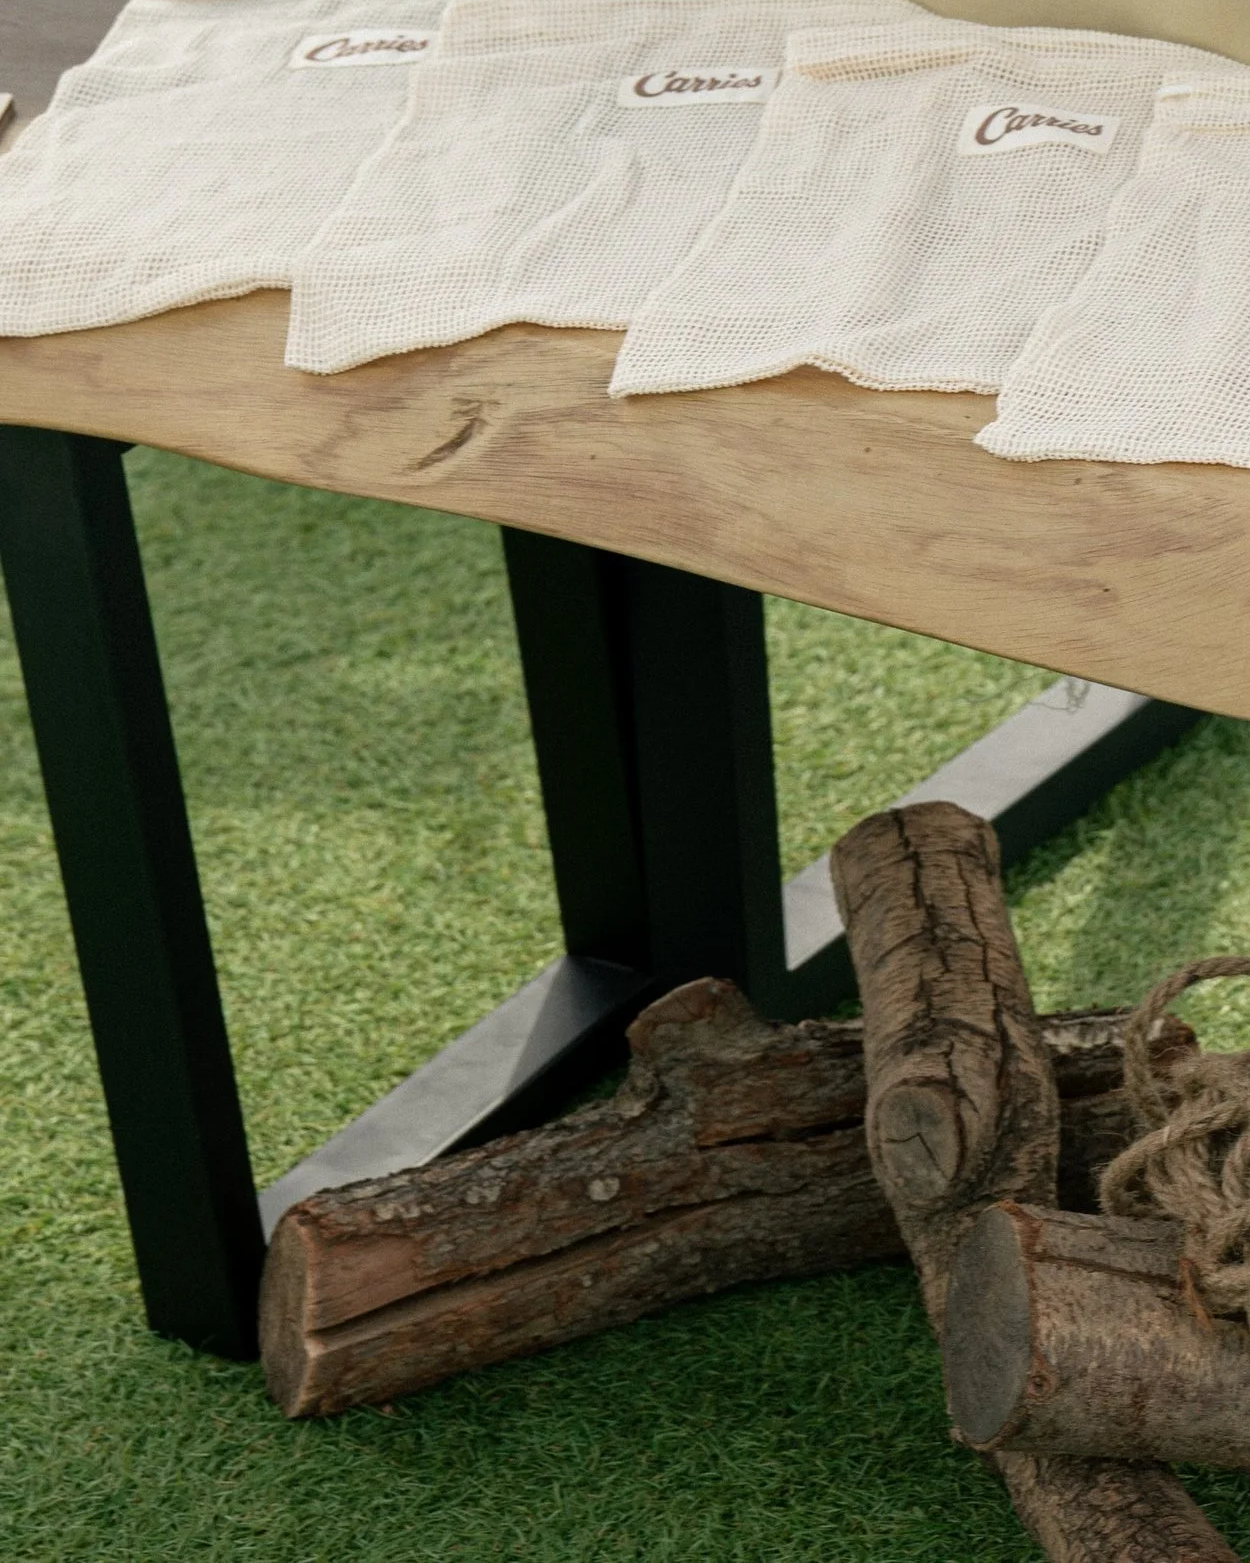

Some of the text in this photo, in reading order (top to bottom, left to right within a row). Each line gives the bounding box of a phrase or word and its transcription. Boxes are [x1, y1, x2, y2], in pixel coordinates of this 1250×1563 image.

[304, 34, 429, 63] Carries
[633, 70, 762, 98] Carries
[974, 106, 1104, 146] Carries
